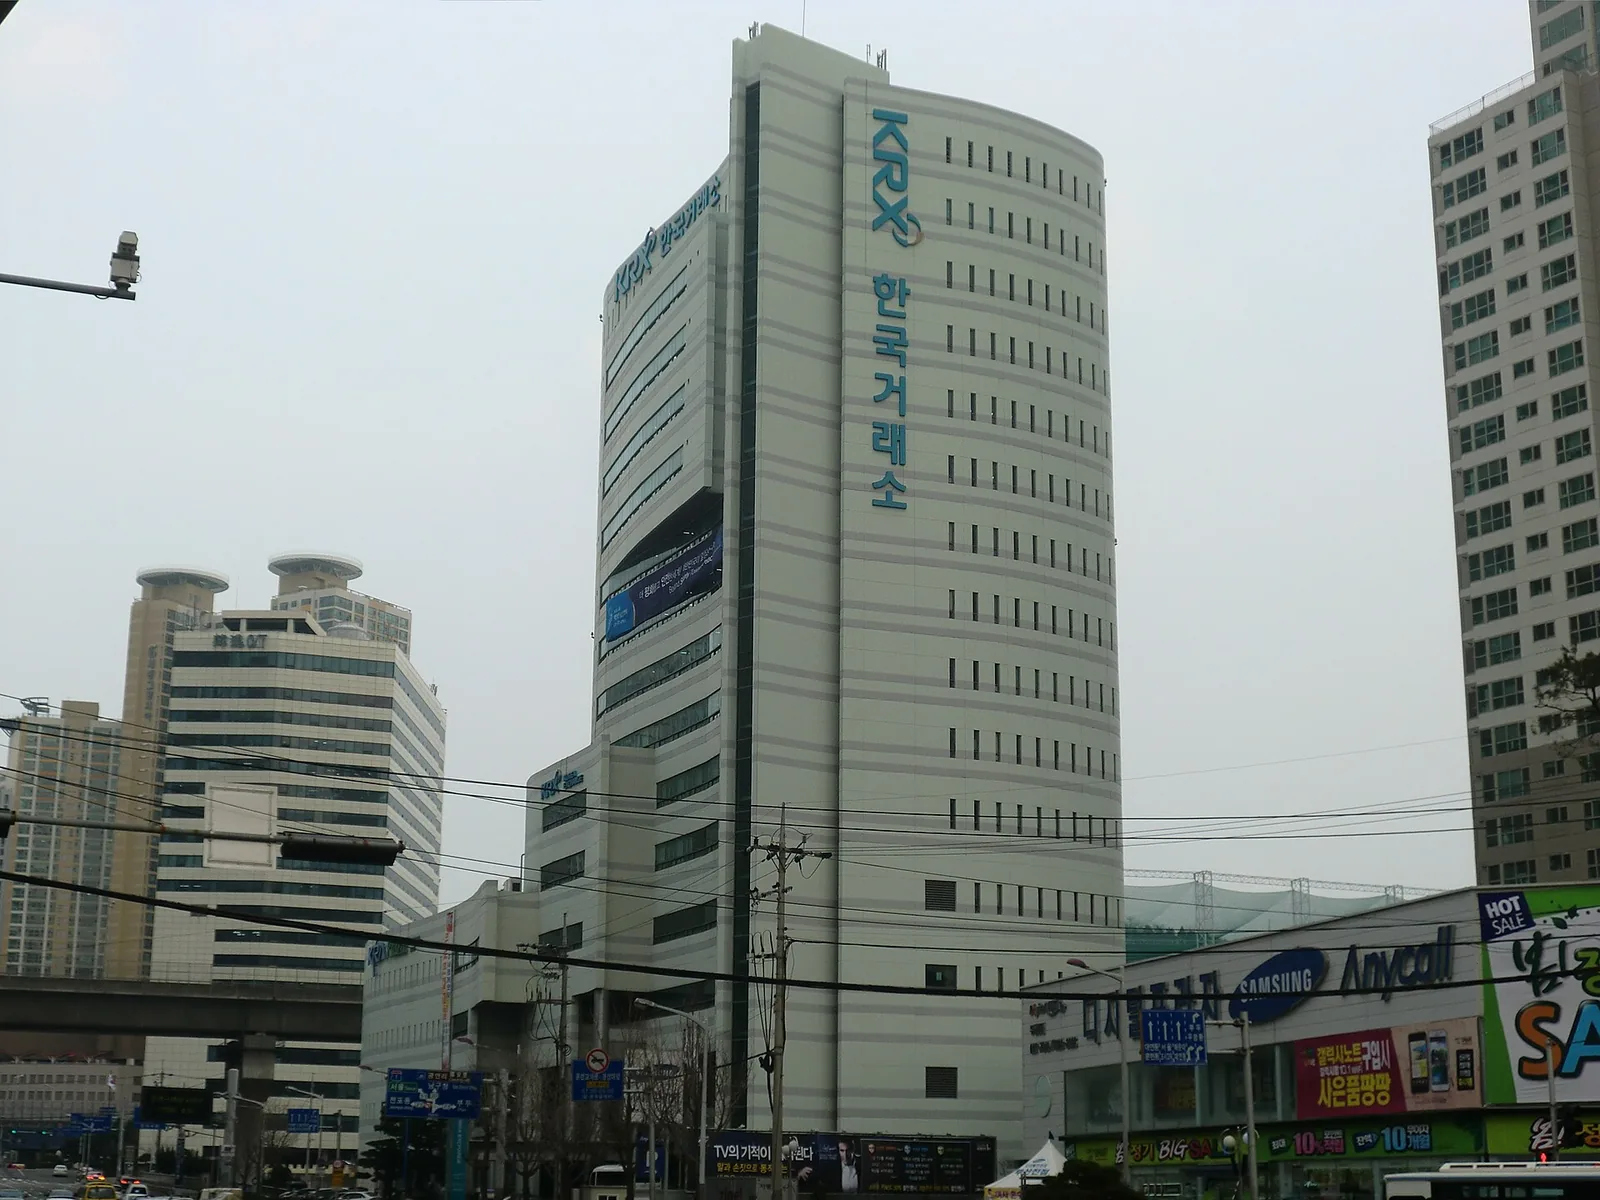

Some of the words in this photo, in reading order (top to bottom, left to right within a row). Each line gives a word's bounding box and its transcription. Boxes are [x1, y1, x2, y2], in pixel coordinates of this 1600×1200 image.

[873, 108, 912, 237] KRX
[614, 232, 657, 302] KRX
[872, 273, 911, 509] 한국거래소
[1485, 896, 1521, 919] HOT
[1492, 913, 1527, 935] SALE
[1240, 969, 1313, 1003] SAMSUNG
[1340, 925, 1453, 1002] Anycall
[1361, 1040, 1391, 1070] 구입시
[1130, 1143, 1155, 1162] 정기
[1159, 1138, 1189, 1160] BIG
[1380, 1126, 1406, 1151] 10
[713, 1144, 740, 1160] TV의
[741, 1145, 772, 1161] 기적이
